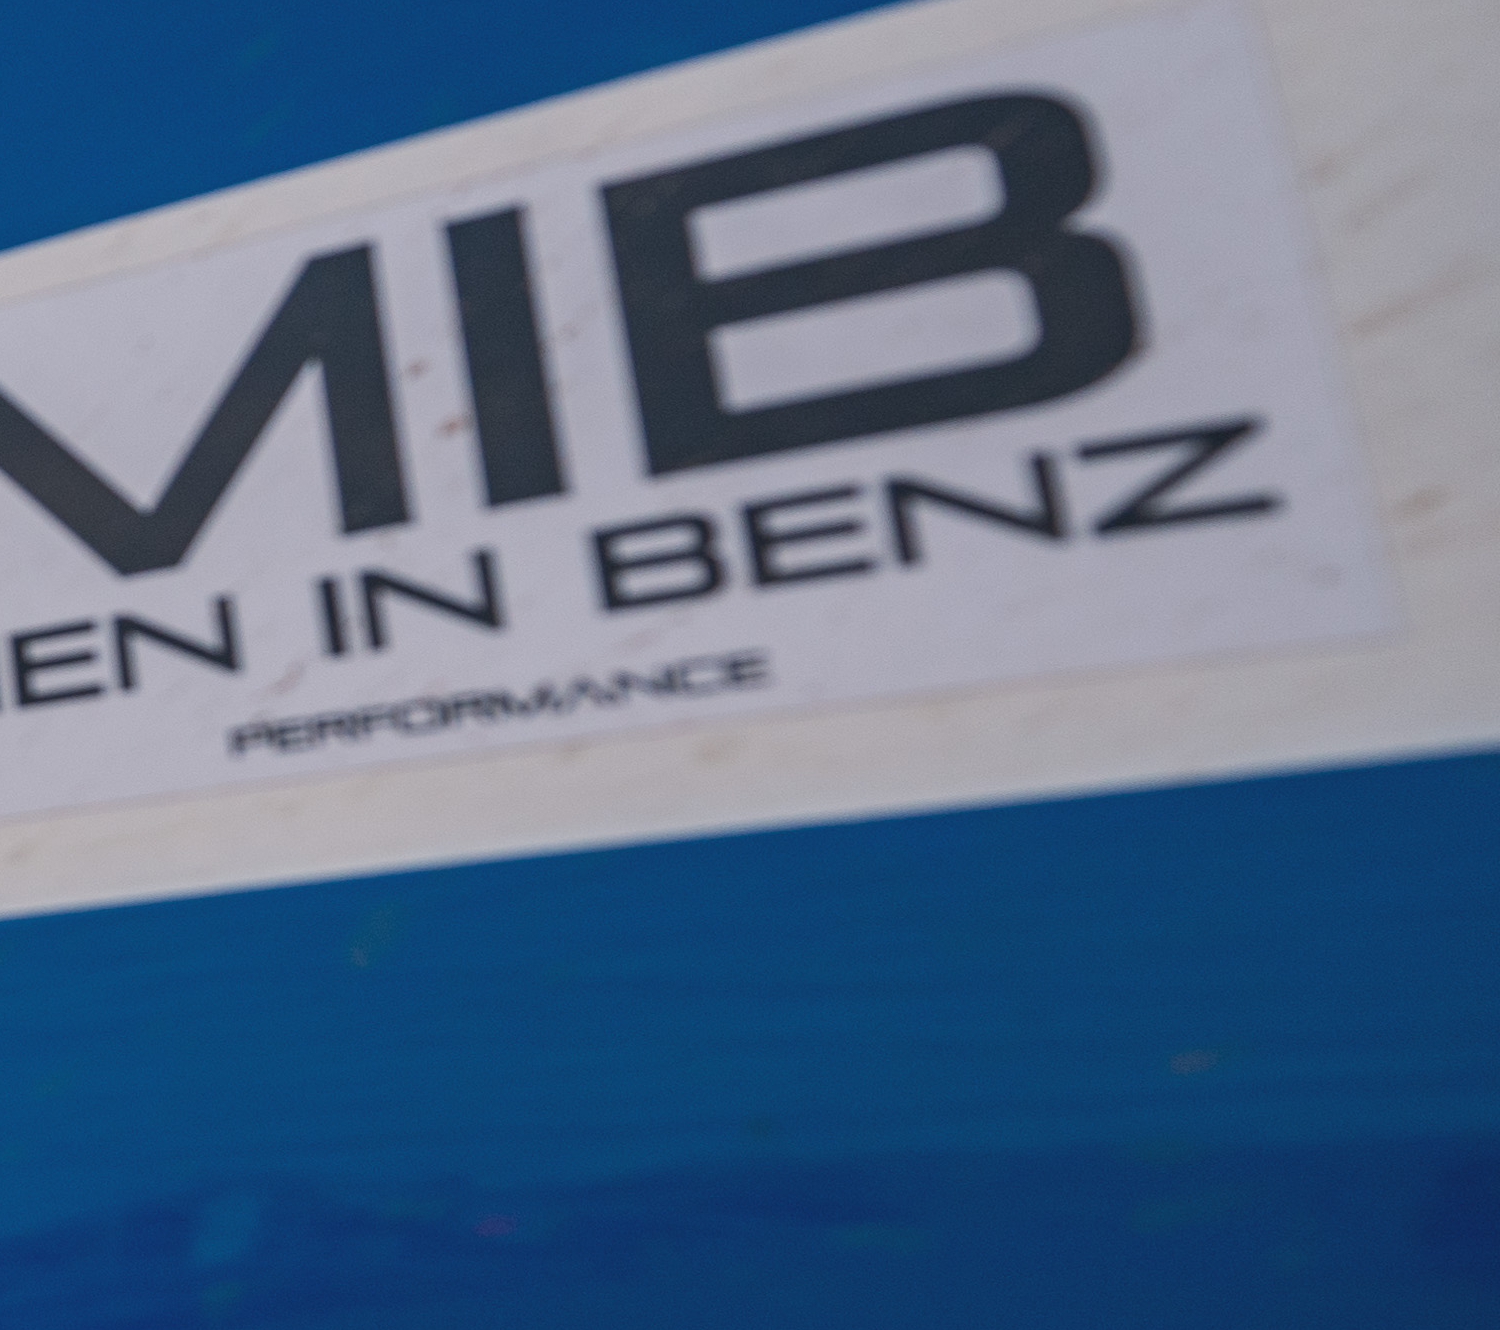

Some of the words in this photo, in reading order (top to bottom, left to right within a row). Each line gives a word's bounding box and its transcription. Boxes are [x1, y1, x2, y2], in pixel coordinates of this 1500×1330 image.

[319, 547, 507, 658] IN
[589, 416, 1286, 615] BENZ
[226, 650, 776, 759] PERFORMANCE
